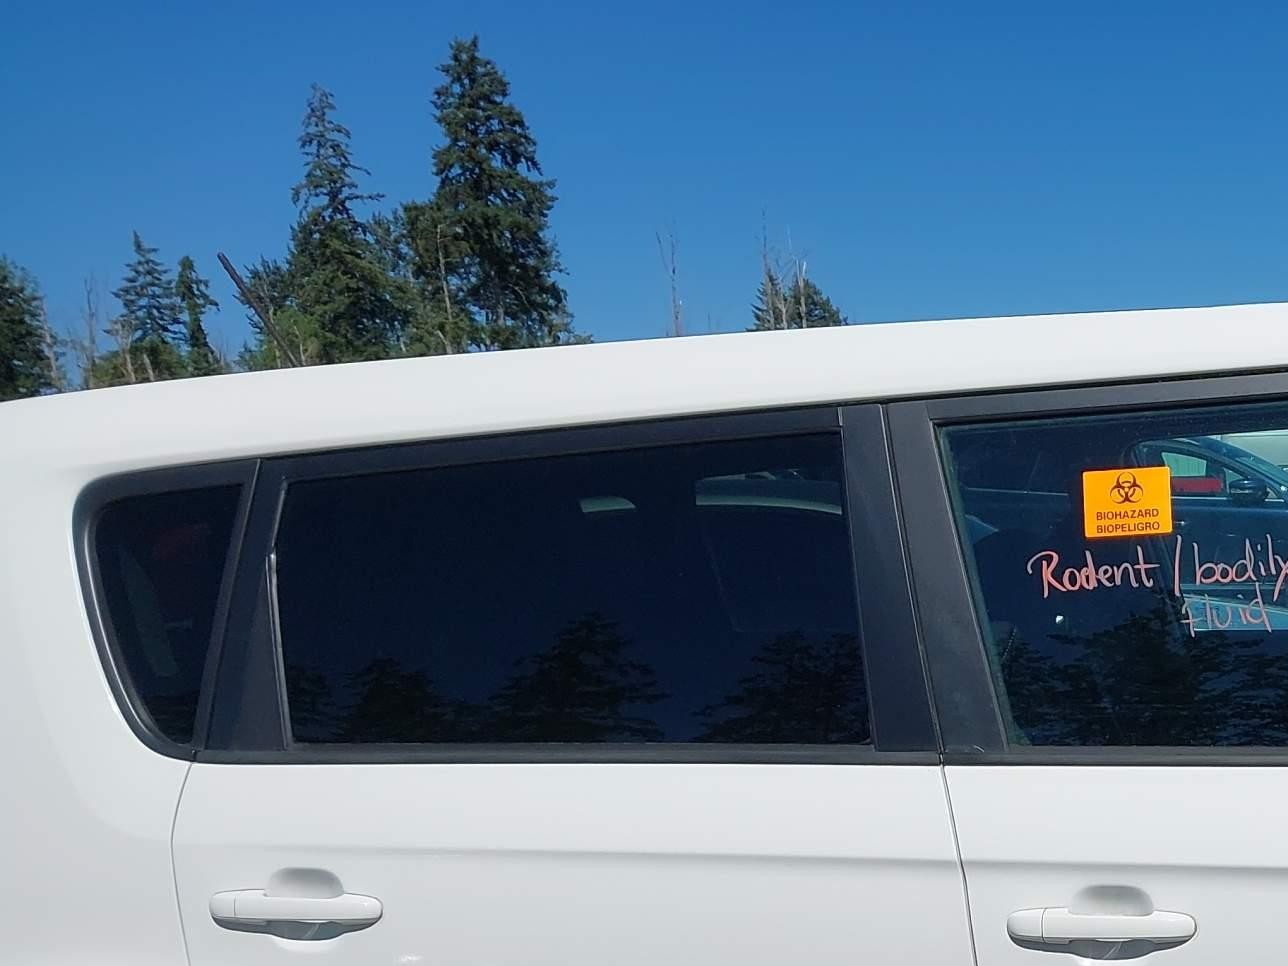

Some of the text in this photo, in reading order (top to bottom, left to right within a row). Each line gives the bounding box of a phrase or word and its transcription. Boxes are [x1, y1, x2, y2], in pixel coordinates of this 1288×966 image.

[1096, 507, 1160, 521] BIOHAZARD
[1096, 521, 1160, 534] BIOPELIGRO
[1026, 545, 1160, 599] Rodent
